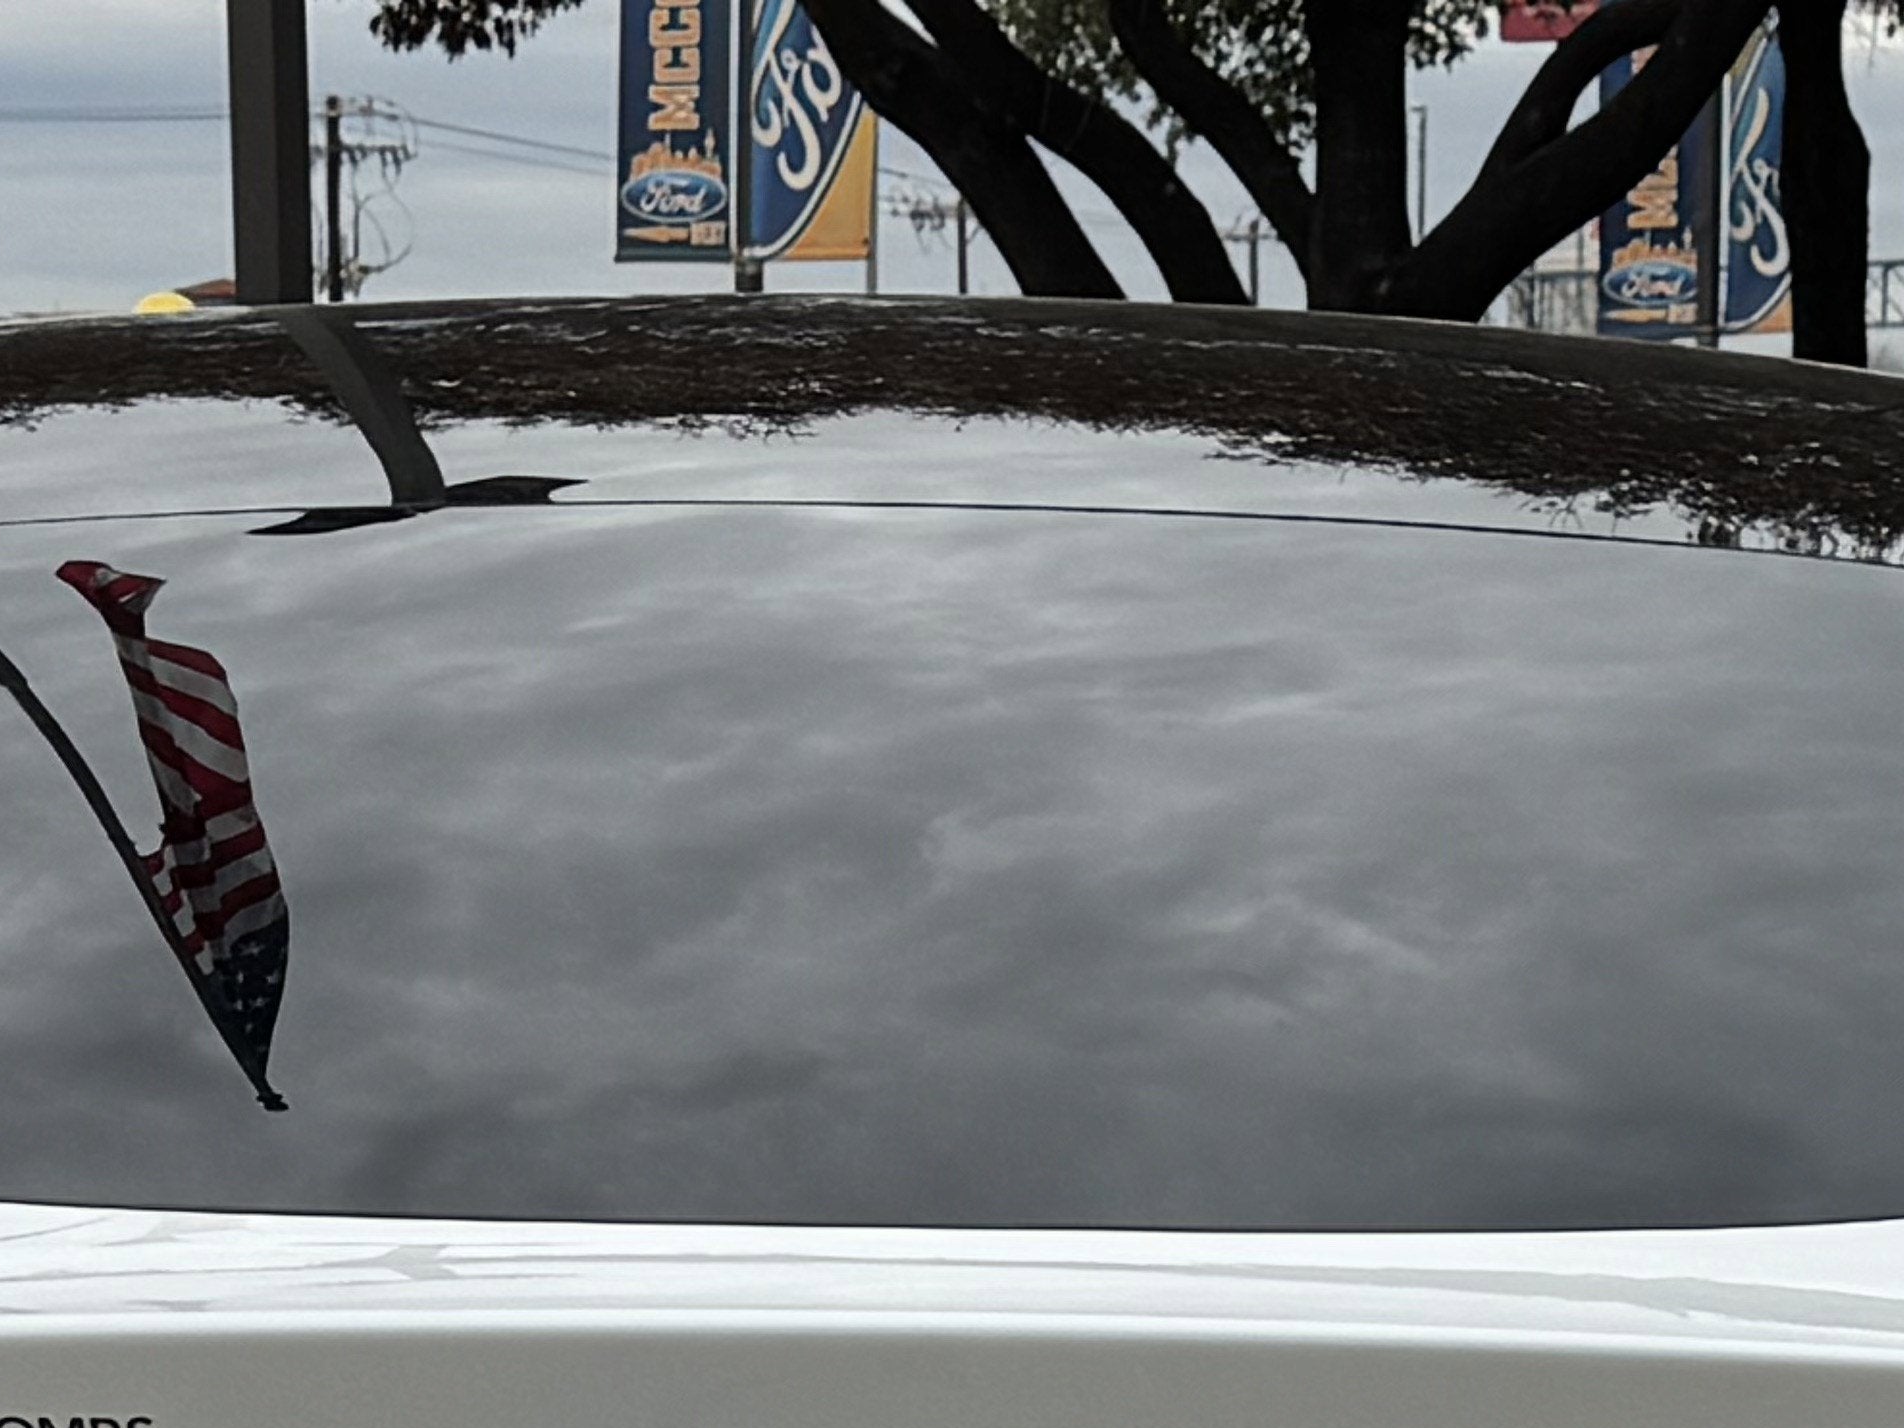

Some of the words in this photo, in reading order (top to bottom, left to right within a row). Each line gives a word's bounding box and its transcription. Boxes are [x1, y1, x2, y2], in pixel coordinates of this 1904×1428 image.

[648, 0, 701, 130] MCC
[751, 0, 843, 190] Fo
[639, 177, 708, 213] Ford
